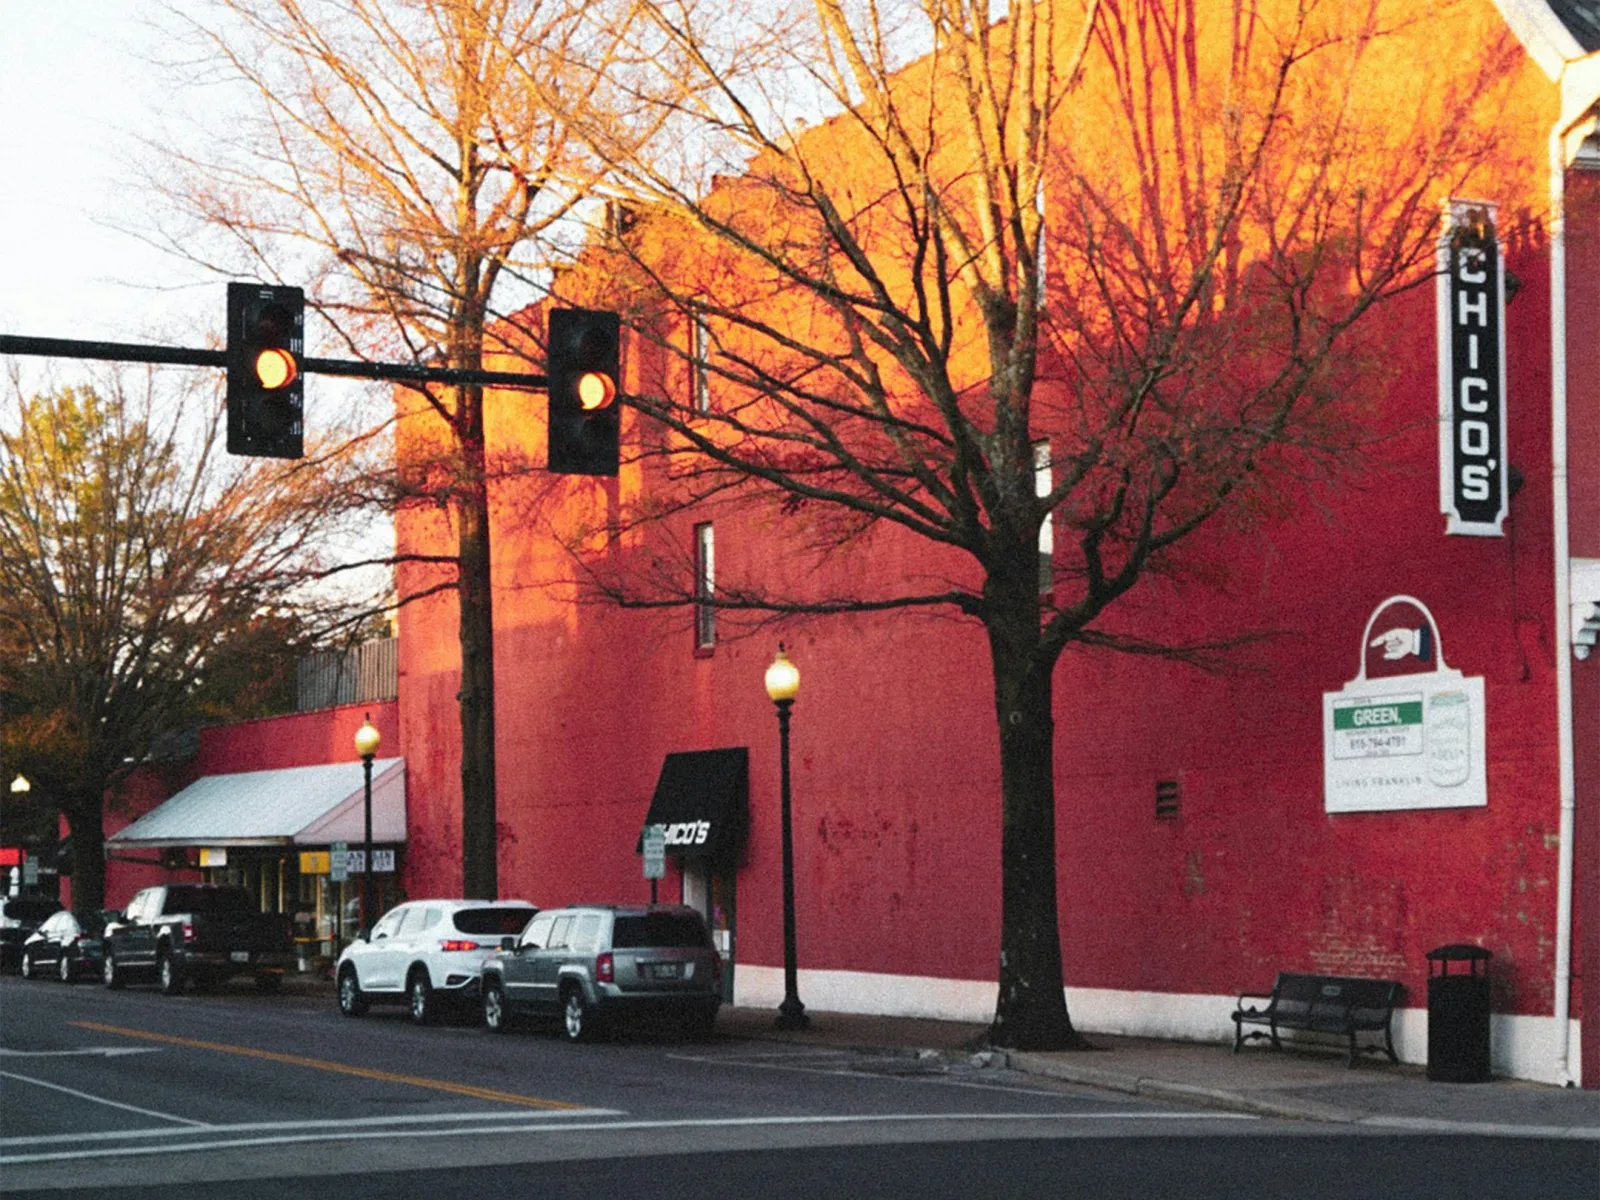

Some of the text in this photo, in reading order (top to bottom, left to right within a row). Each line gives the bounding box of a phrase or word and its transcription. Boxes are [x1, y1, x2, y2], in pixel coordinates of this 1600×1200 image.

[1458, 247, 1496, 501] CHICO'S
[1372, 776, 1422, 786] FRANKLIN
[655, 820, 711, 845] HICO'S
